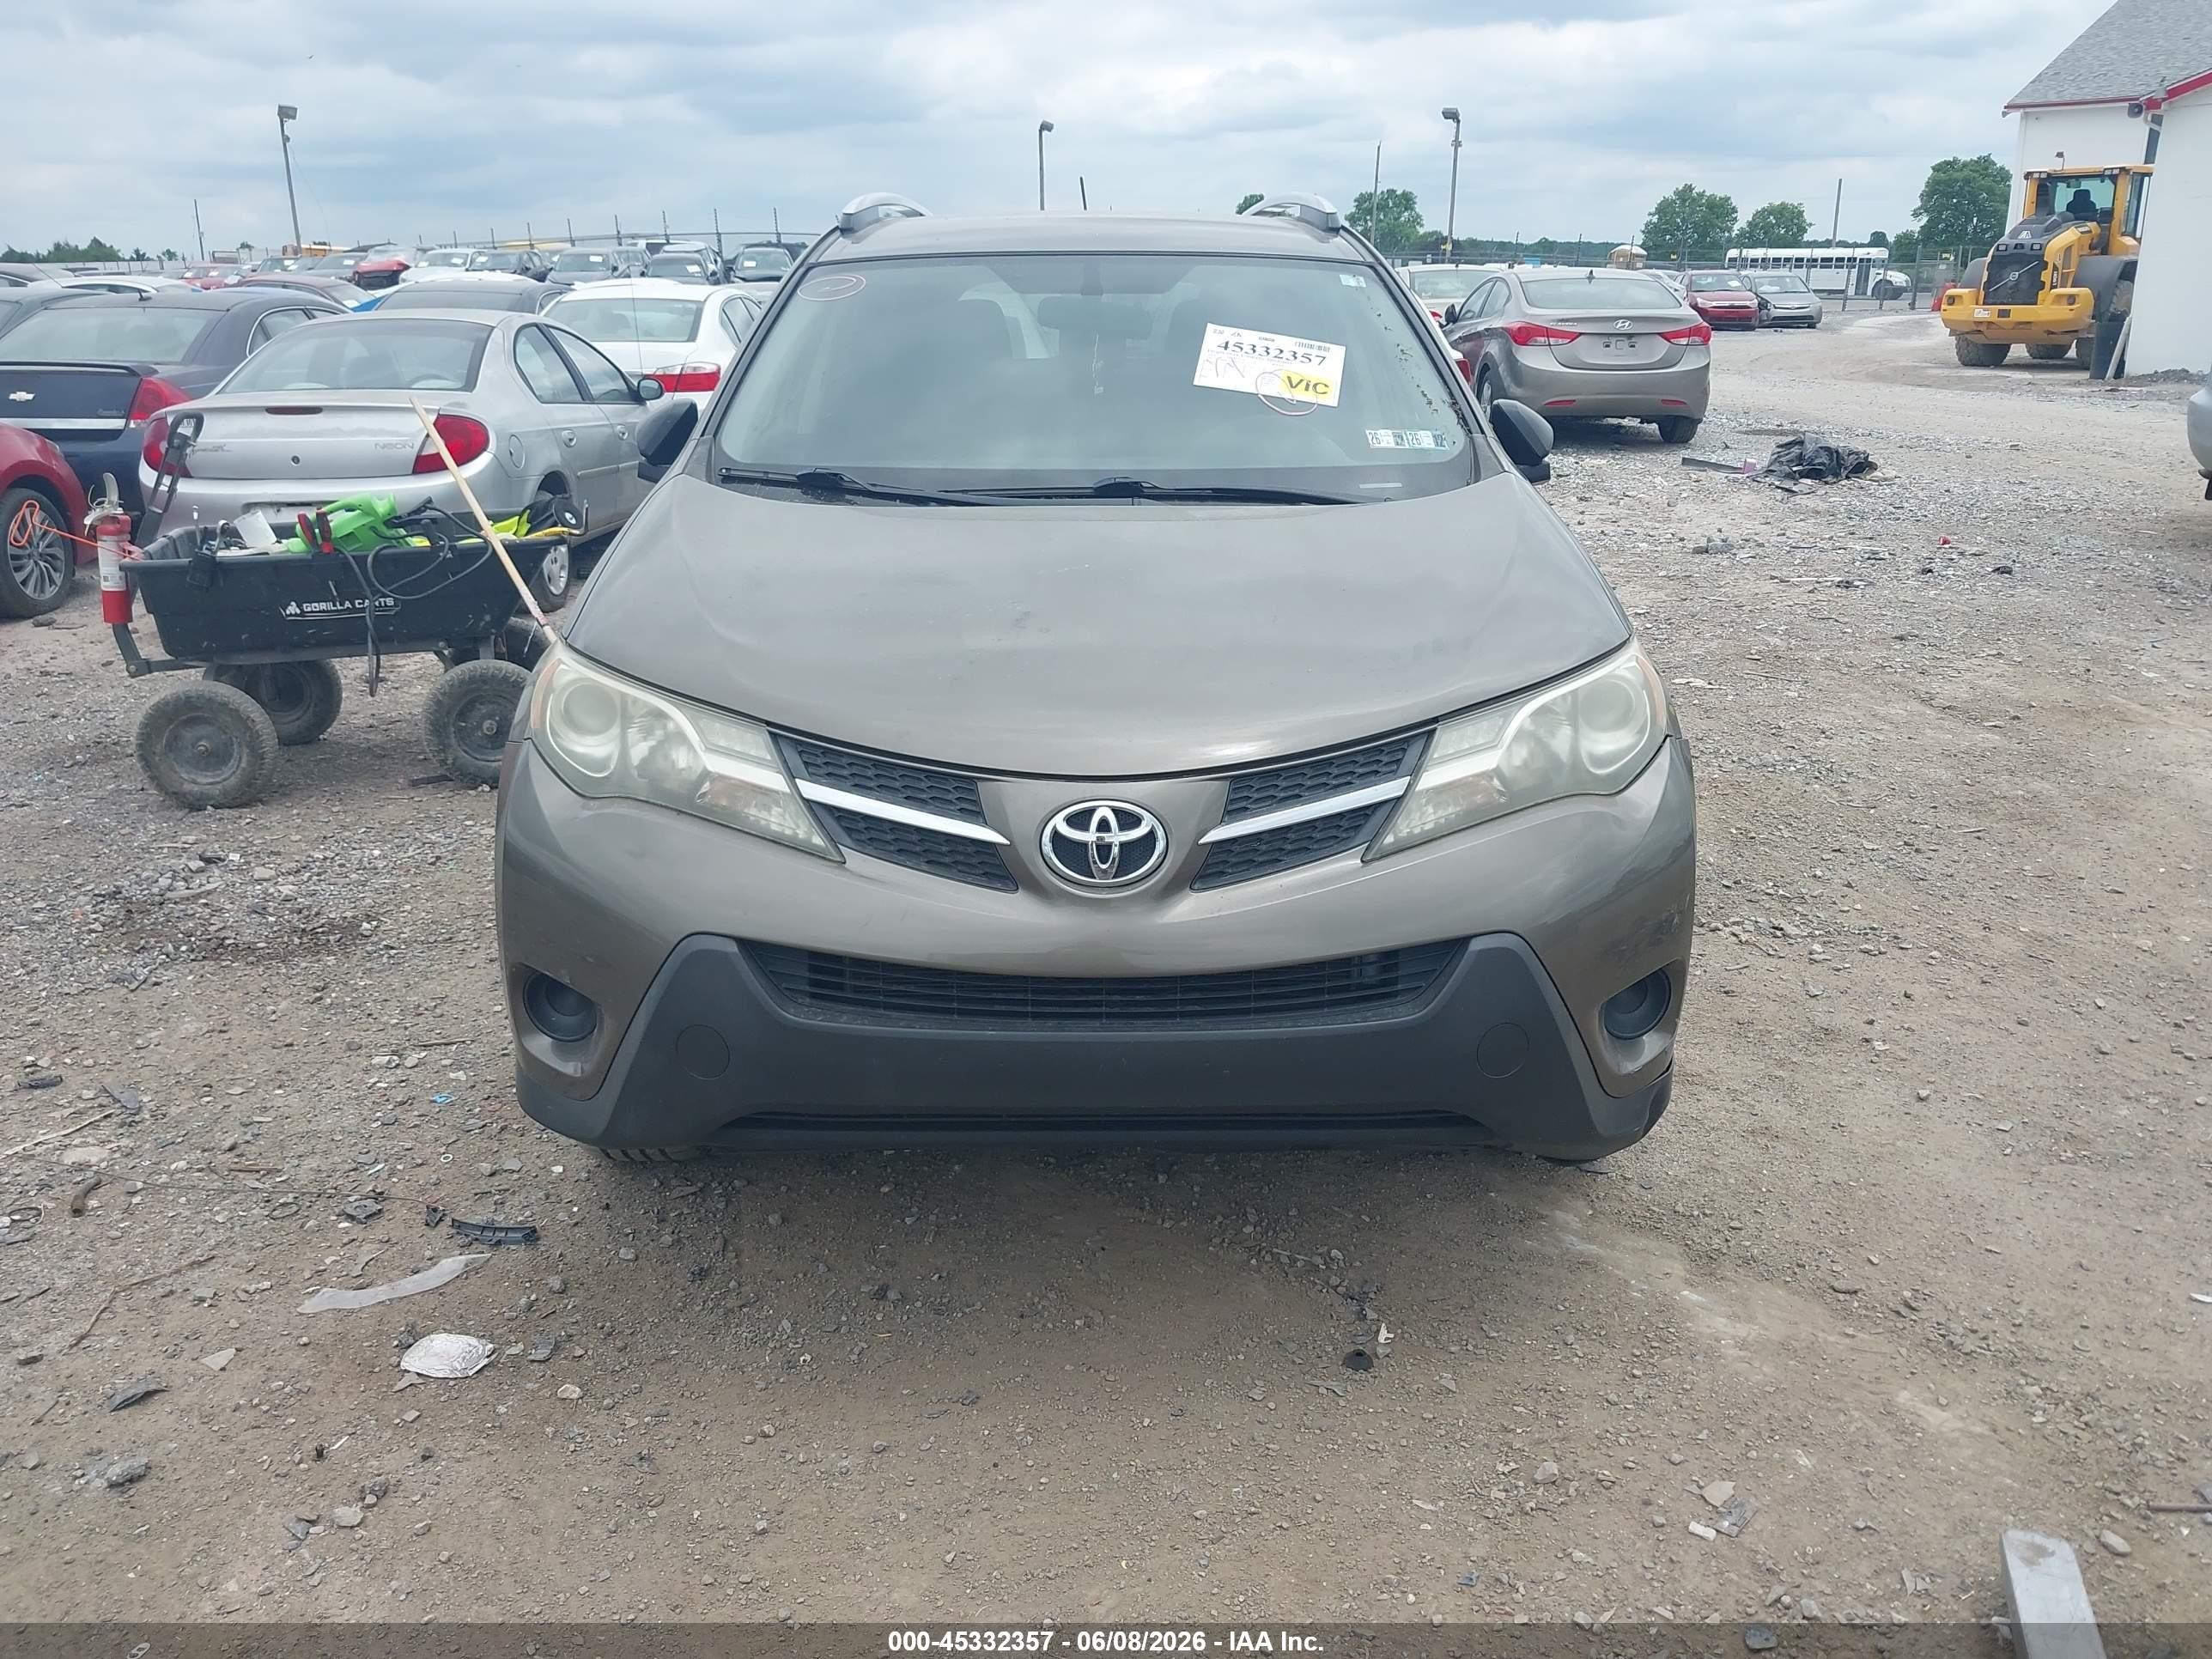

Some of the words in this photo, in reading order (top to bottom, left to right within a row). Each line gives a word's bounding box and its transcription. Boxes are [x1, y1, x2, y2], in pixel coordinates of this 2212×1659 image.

[1217, 340, 1327, 367] 45332357
[1368, 431, 1382, 445] 26
[1408, 432, 1422, 446] 26
[374, 441, 415, 451] NEON
[302, 600, 352, 612] GORILLA
